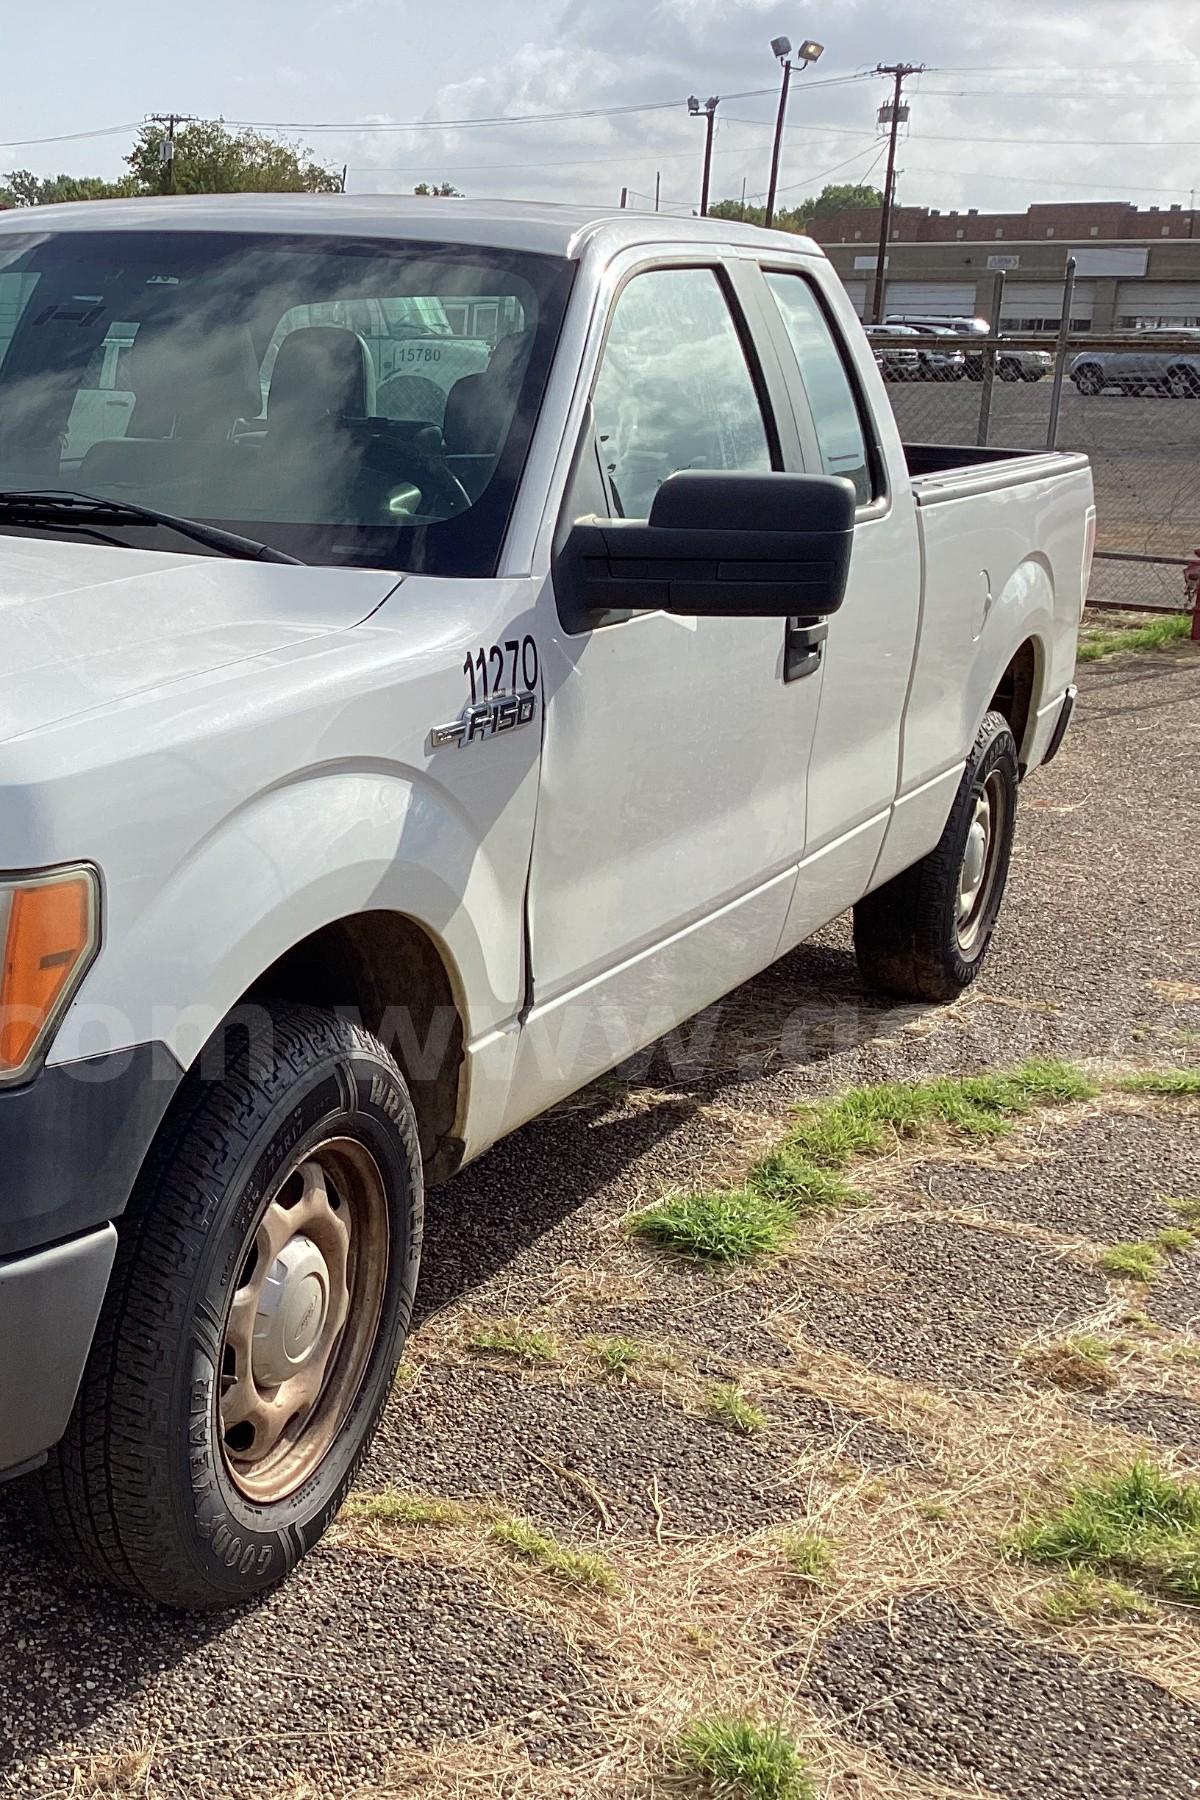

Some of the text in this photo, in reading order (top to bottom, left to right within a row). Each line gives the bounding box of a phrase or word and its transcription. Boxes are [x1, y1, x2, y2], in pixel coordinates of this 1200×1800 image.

[400, 347, 441, 362] 15780
[463, 634, 538, 706] 11270
[367, 1072, 423, 1262] WRANGLER
[188, 1378, 273, 1575] GOODYEAR
